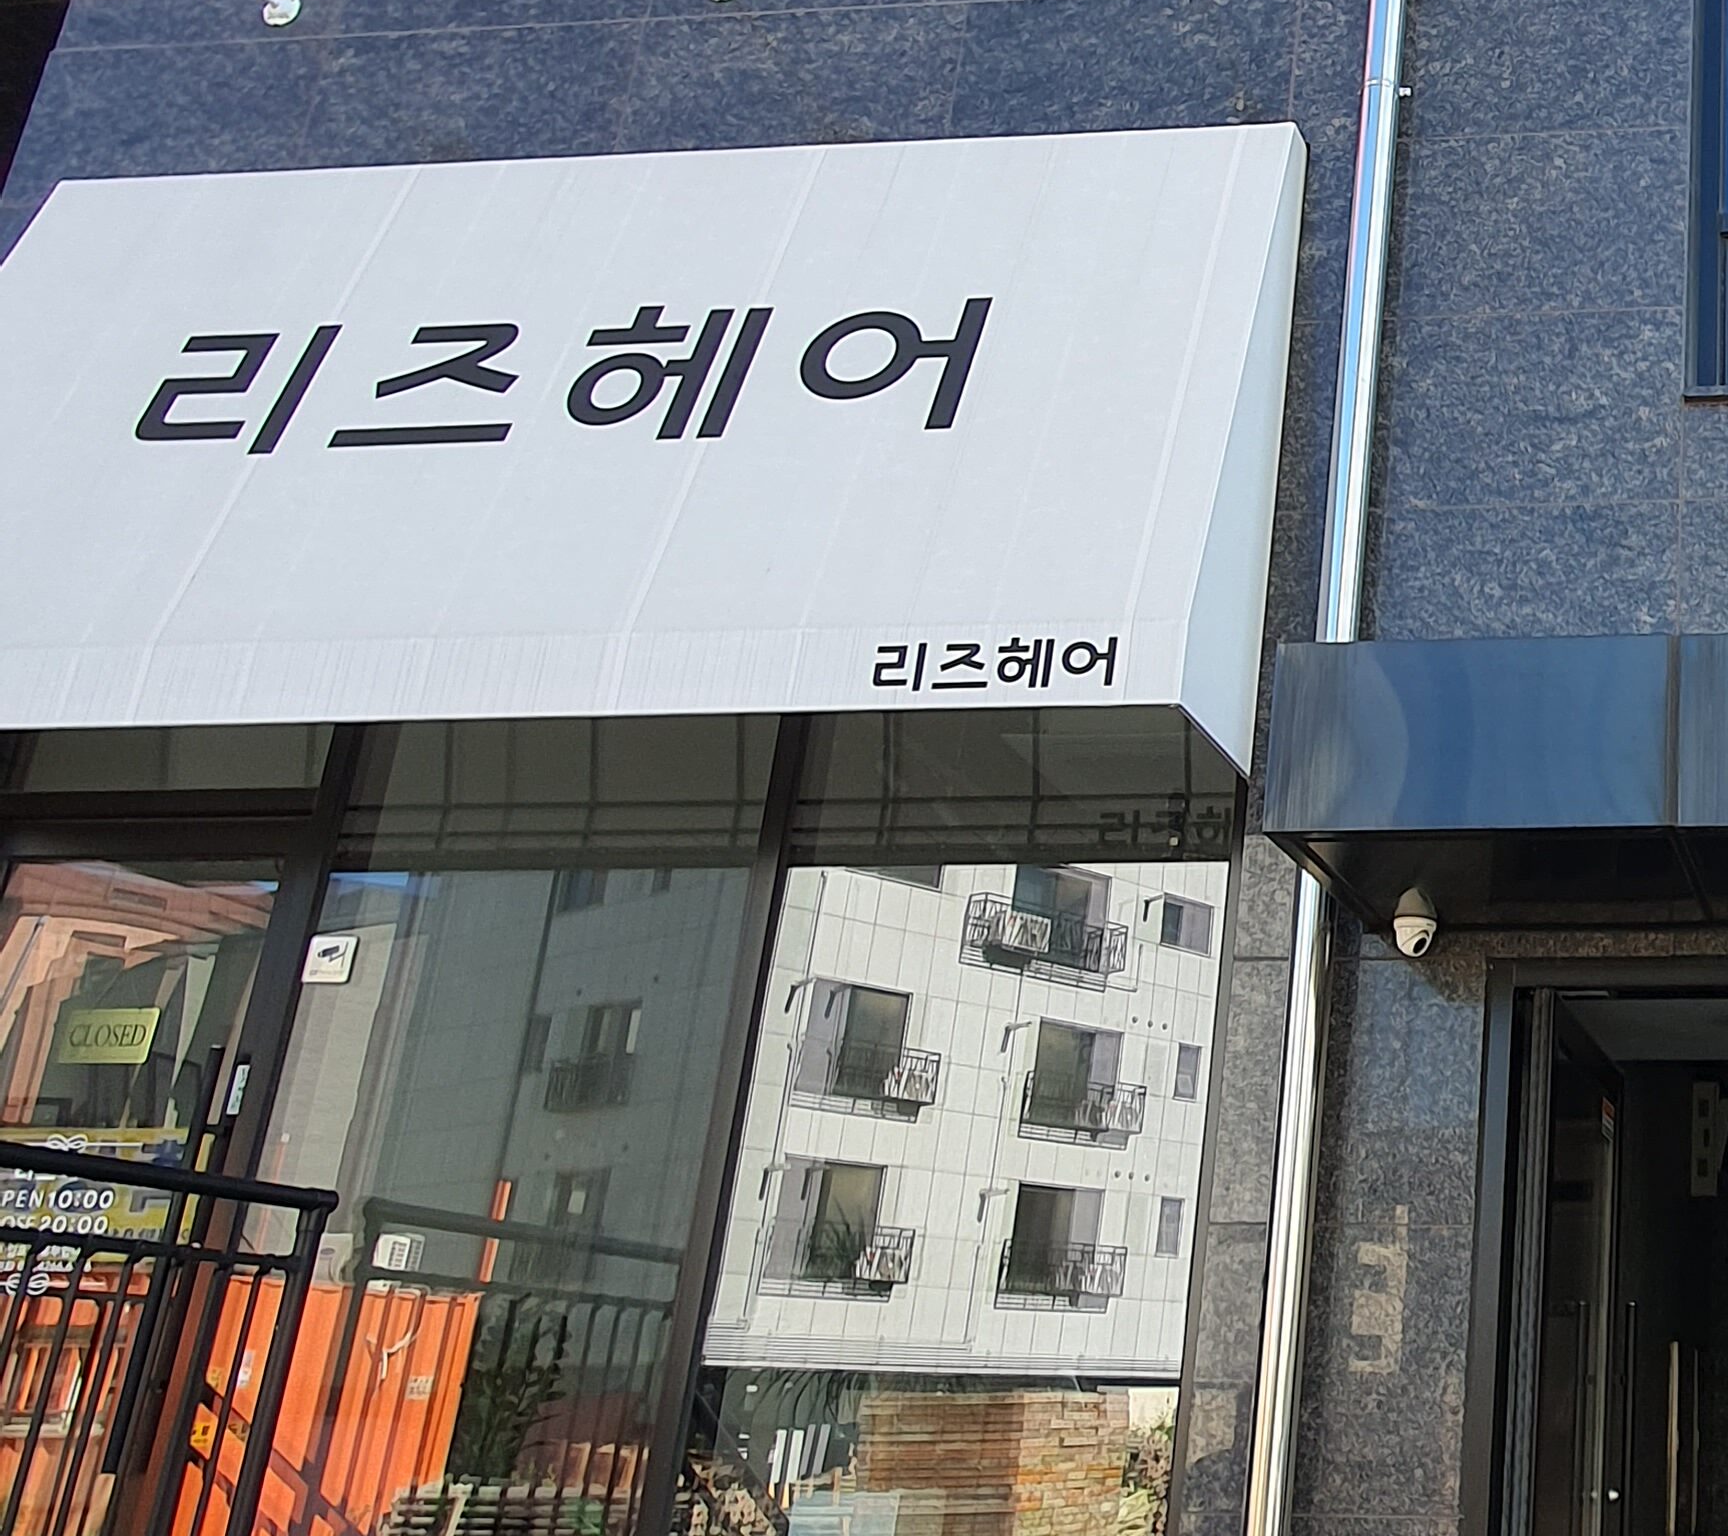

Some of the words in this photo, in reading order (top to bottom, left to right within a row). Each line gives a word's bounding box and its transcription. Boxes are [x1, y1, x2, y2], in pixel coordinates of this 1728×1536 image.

[134, 296, 993, 455] 리즈헤어
[871, 635, 1120, 690] 리즈헤어
[69, 1023, 147, 1048] CLOSED
[0, 1190, 44, 1208] PEN
[47, 1189, 115, 1210] 10:00
[38, 1215, 109, 1235] 20:00
